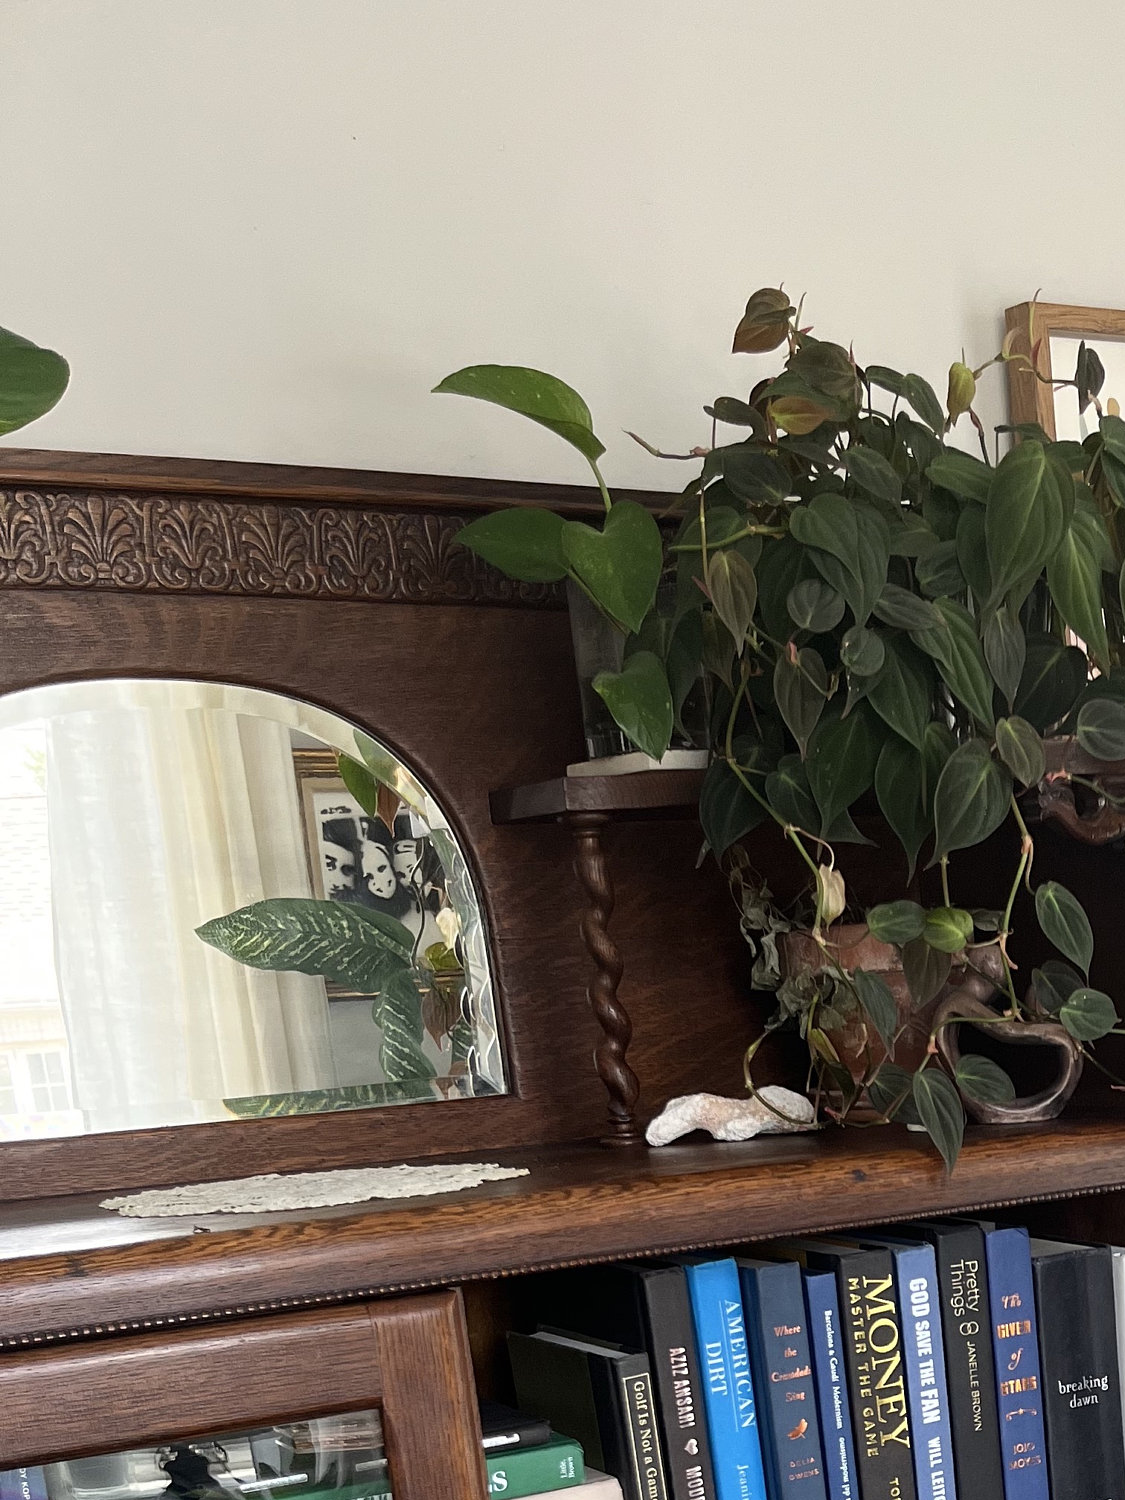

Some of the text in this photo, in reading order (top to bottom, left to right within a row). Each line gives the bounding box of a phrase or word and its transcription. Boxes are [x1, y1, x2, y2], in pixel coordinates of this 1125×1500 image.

[909, 1277, 930, 1318] GOD
[950, 1259, 965, 1317] Things
[965, 1260, 980, 1312] Pretty
[914, 1320, 932, 1357] SAVE
[997, 1320, 1031, 1339] GIVER
[706, 1341, 728, 1396] DIRT
[725, 1300, 756, 1428] AMERICAN
[848, 1278, 879, 1458] MASTER THE GAME
[862, 1274, 911, 1448] MONEY
[918, 1359, 936, 1387] THE
[669, 1347, 695, 1428] AZIZ ANSARI
[920, 1389, 941, 1424] FAN
[966, 1341, 982, 1432] JANELLE BROWN
[1058, 1375, 1109, 1395] breaking
[1069, 1394, 1099, 1409] dawn
[927, 1436, 943, 1468] WILL
